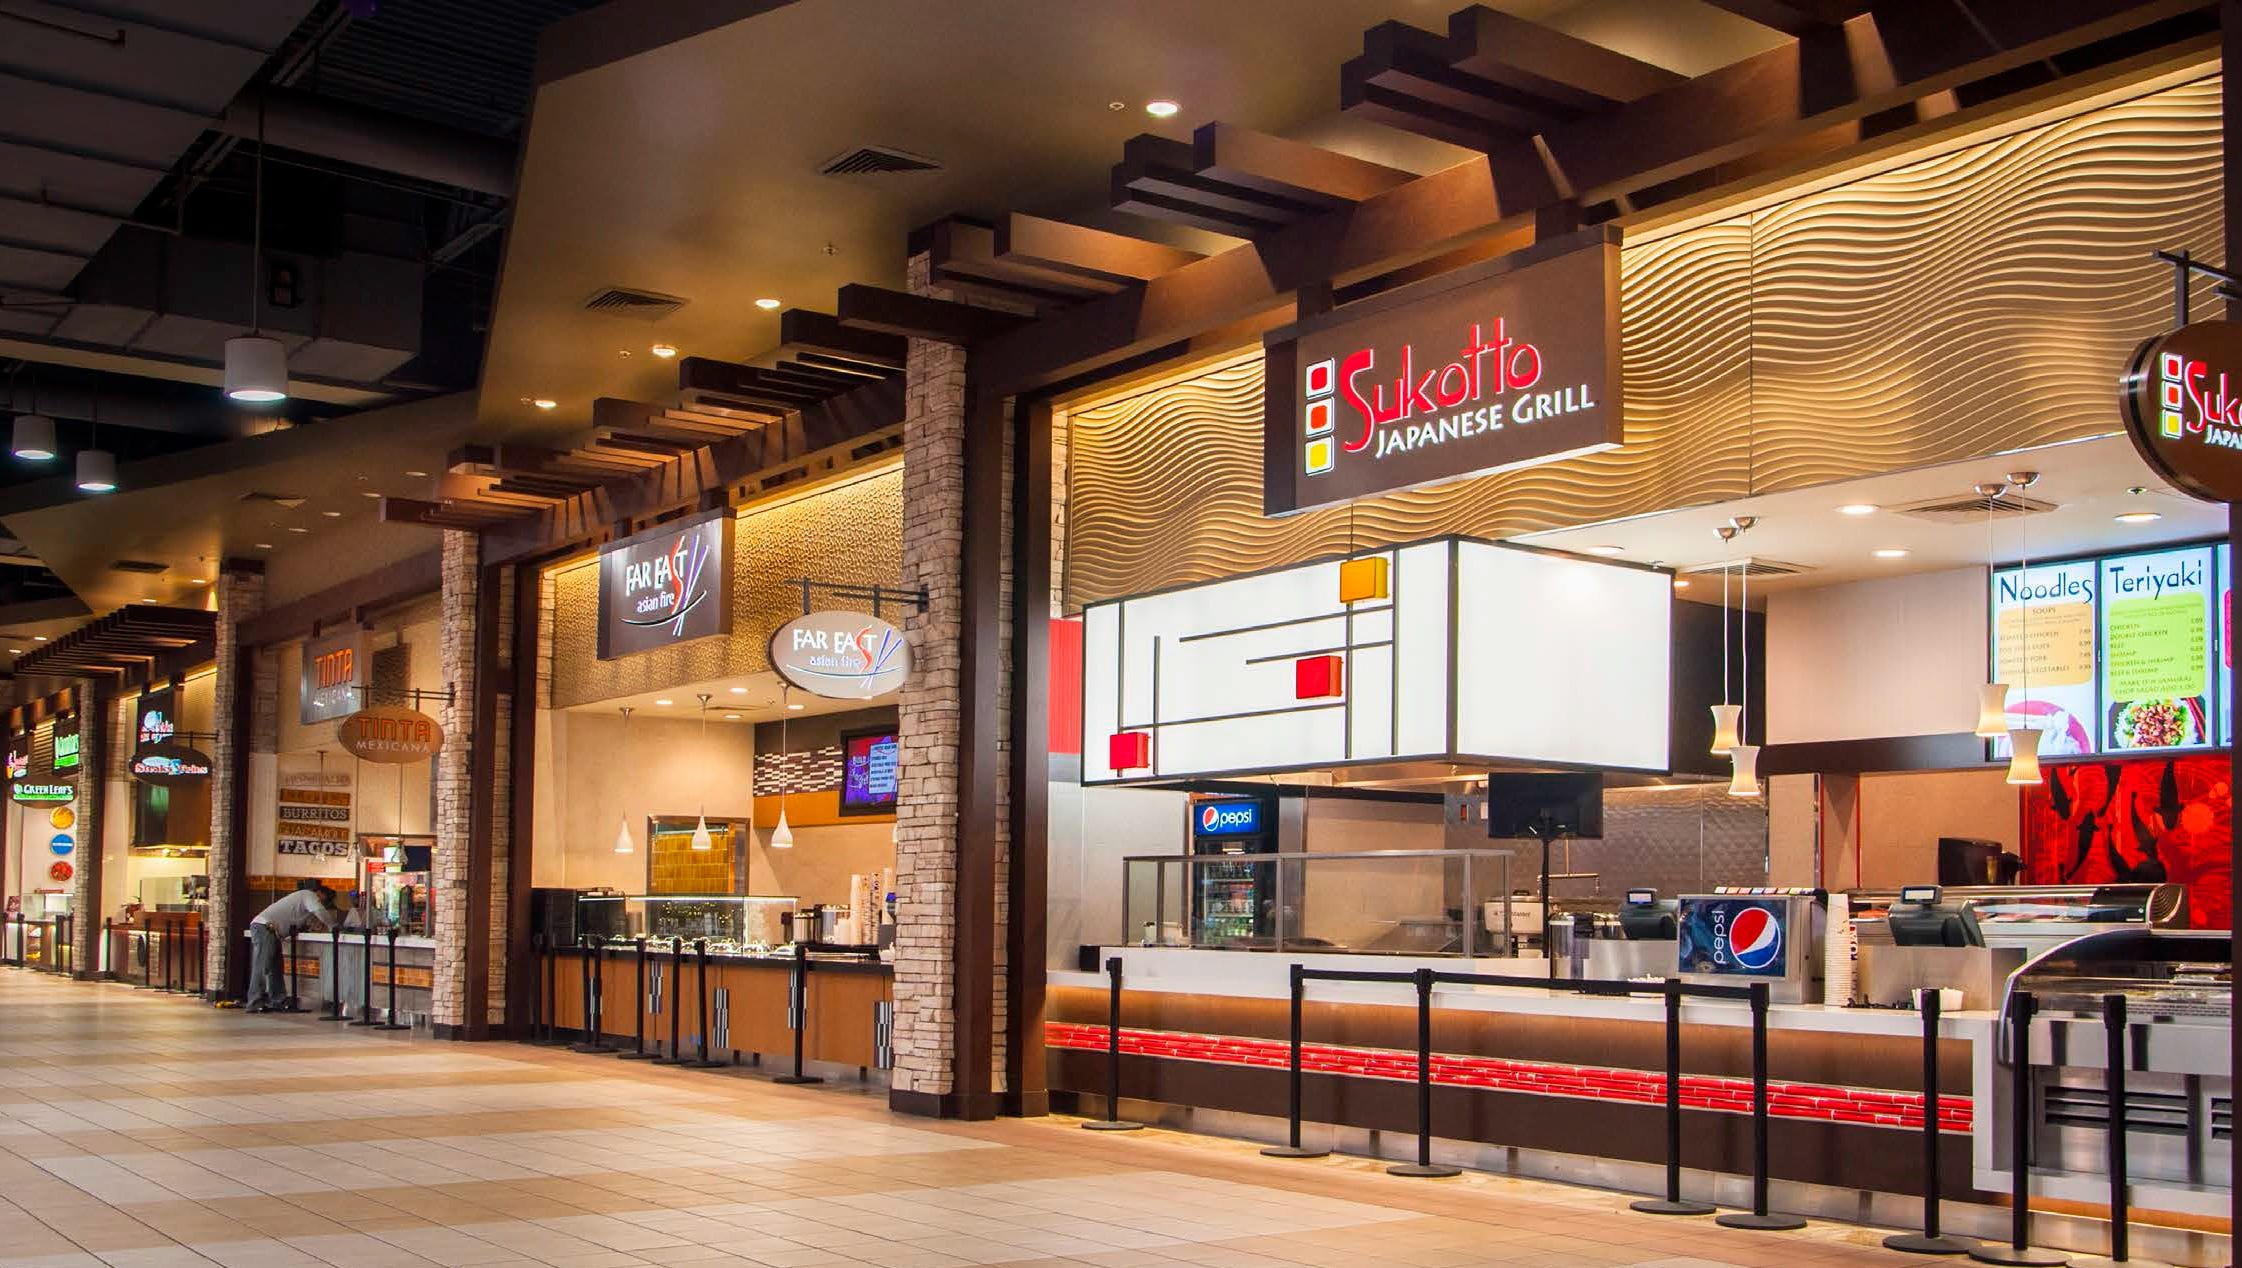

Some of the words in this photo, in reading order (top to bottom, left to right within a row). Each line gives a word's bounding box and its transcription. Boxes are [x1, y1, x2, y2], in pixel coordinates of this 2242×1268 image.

[1340, 317, 1542, 453] Sukotto
[2184, 361, 2242, 433] Suk
[1374, 404, 1504, 458] JAPANESE
[1511, 384, 1596, 424] GRILL
[2204, 424, 2242, 450] JAPA
[626, 561, 652, 597] FAR
[2000, 572, 2092, 605] Noodles
[2109, 560, 2201, 600] Teriyaki
[637, 595, 659, 613] asian
[660, 590, 675, 608] fire
[793, 628, 828, 651] FAR
[314, 648, 353, 689] TINTA
[810, 654, 838, 667] asian
[841, 655, 861, 668] fire
[357, 717, 431, 742] TINTA
[355, 740, 431, 753] MEXICANA
[23, 784, 48, 794] GREEN
[283, 808, 347, 819] BURRITOS
[1220, 808, 1252, 828] pepsi
[281, 841, 348, 855] TACOS
[1712, 910, 1726, 965] pepsi
